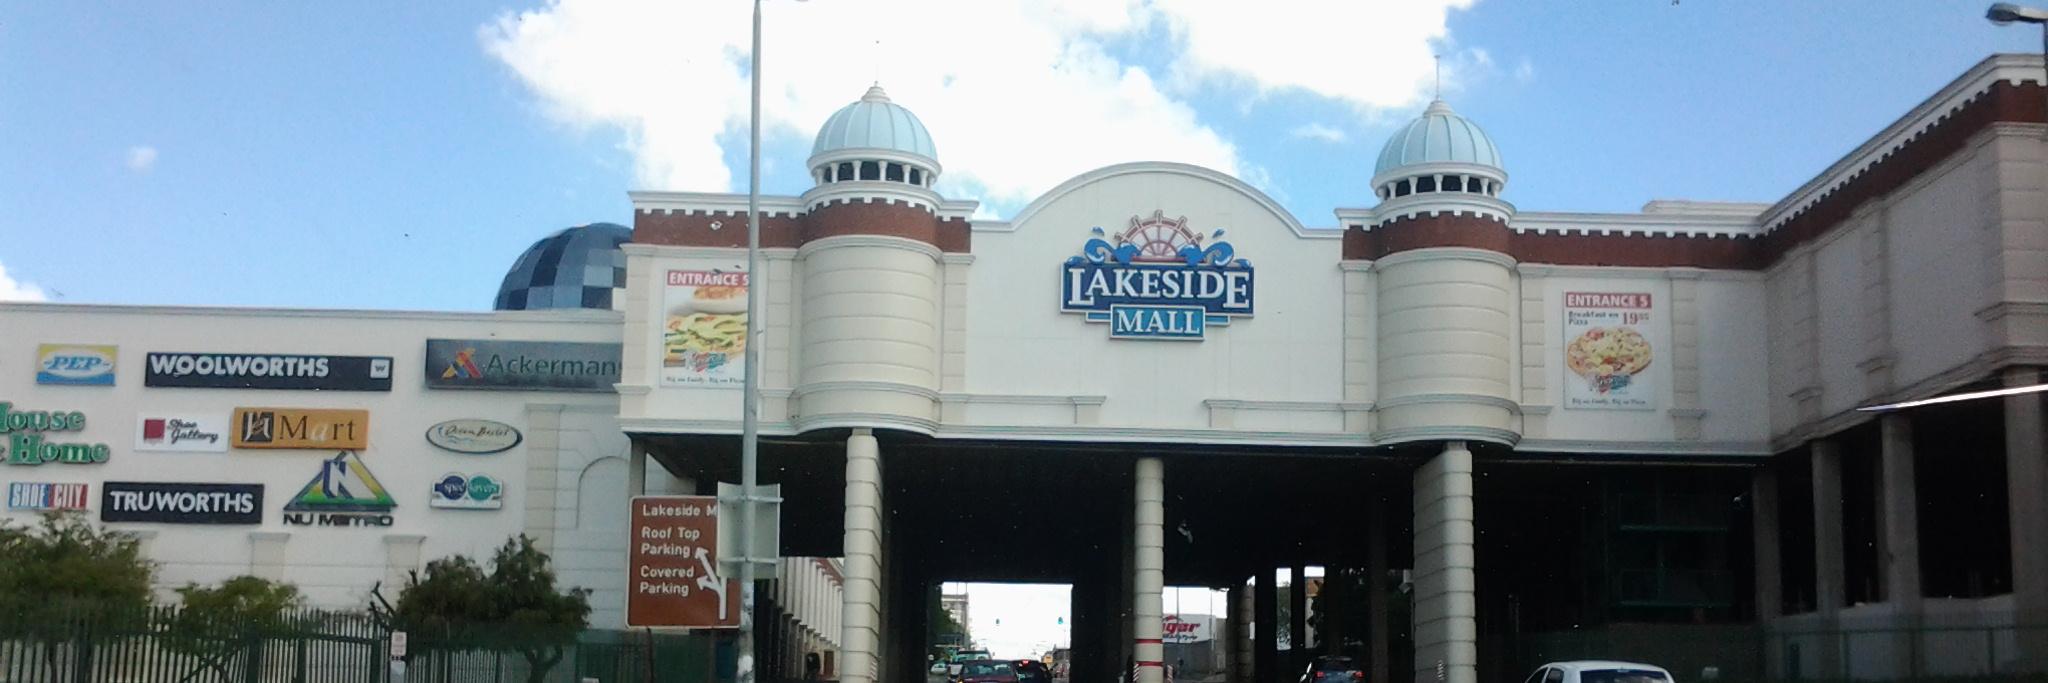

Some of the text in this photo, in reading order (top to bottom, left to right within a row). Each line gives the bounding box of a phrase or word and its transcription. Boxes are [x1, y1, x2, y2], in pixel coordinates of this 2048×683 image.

[668, 272, 740, 286] ENTRANCE
[1068, 267, 1250, 309] LAKESIDE
[1567, 294, 1649, 307] ENTRANCE 5
[1116, 310, 1200, 334] MALL
[47, 356, 103, 371] PEP
[151, 354, 329, 377] WOOLWORTHS
[486, 354, 622, 377] Ackerman
[279, 415, 358, 442] Mart
[7, 432, 110, 466] Home
[12, 483, 84, 509] SHOE CITY
[110, 490, 254, 514] TRUWORTHS
[642, 504, 701, 517] Lakeside
[283, 513, 394, 527] NU METRO
[641, 526, 700, 541] Roof Top
[640, 543, 691, 559] Parking
[640, 565, 695, 578] Covered
[639, 582, 689, 597] Parking
